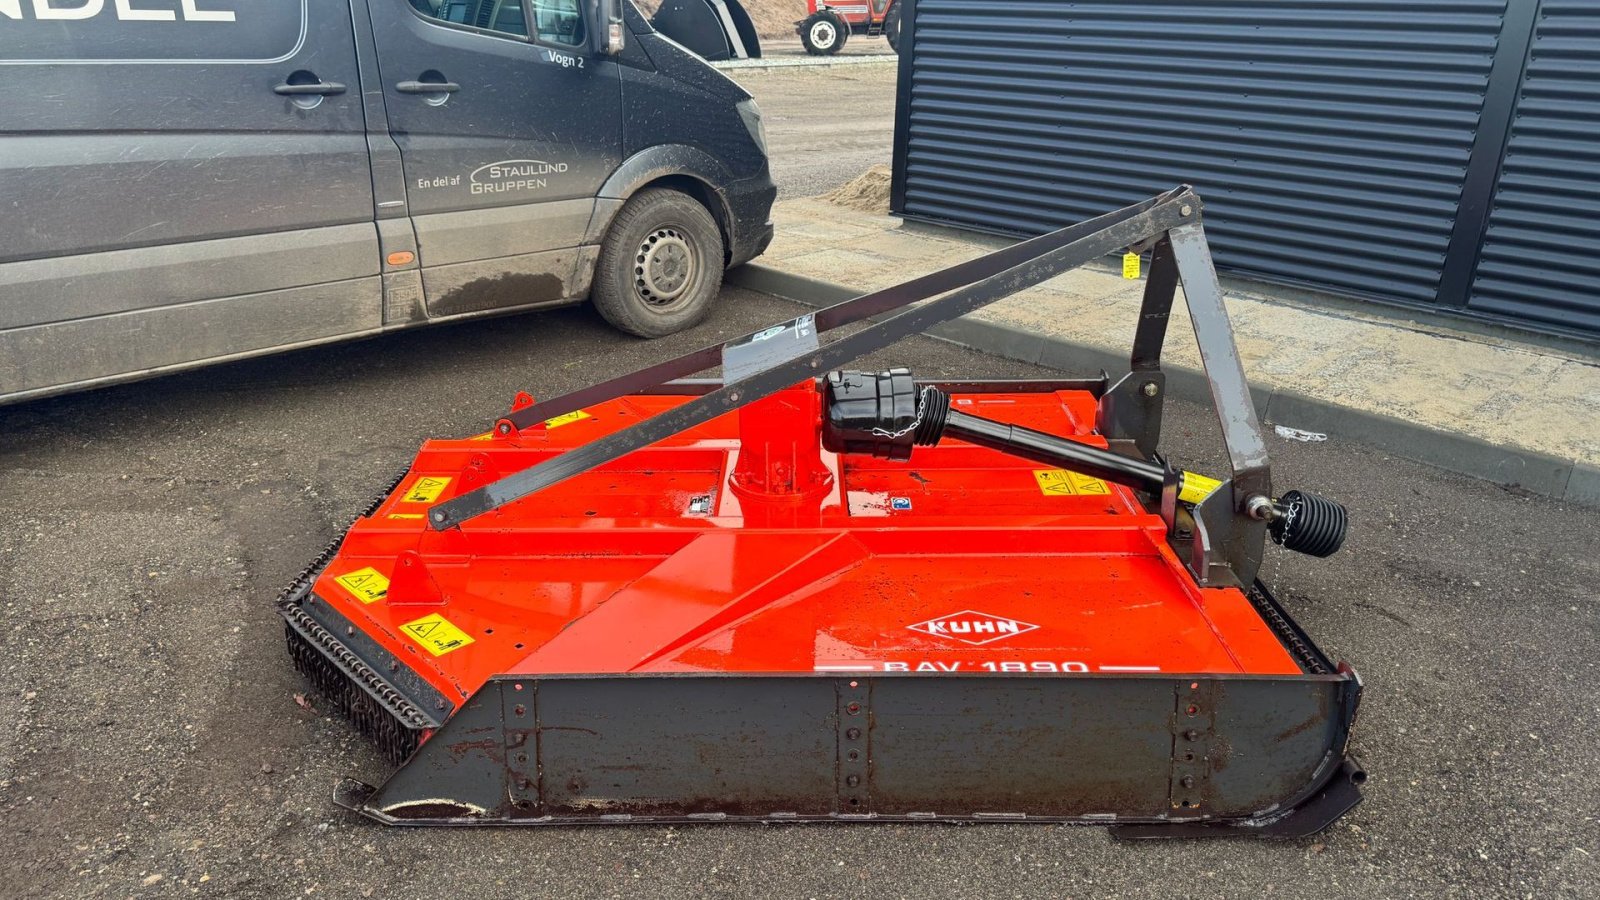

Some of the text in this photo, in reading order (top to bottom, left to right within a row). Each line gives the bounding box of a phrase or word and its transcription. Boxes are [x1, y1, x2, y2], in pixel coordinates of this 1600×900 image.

[548, 50, 584, 68] Vogn 2
[489, 162, 568, 178] STAULUND
[418, 175, 460, 189] En del af
[470, 178, 547, 195] GRUPPEN
[927, 620, 1020, 634] KUHN
[980, 661, 1090, 673] 1890
